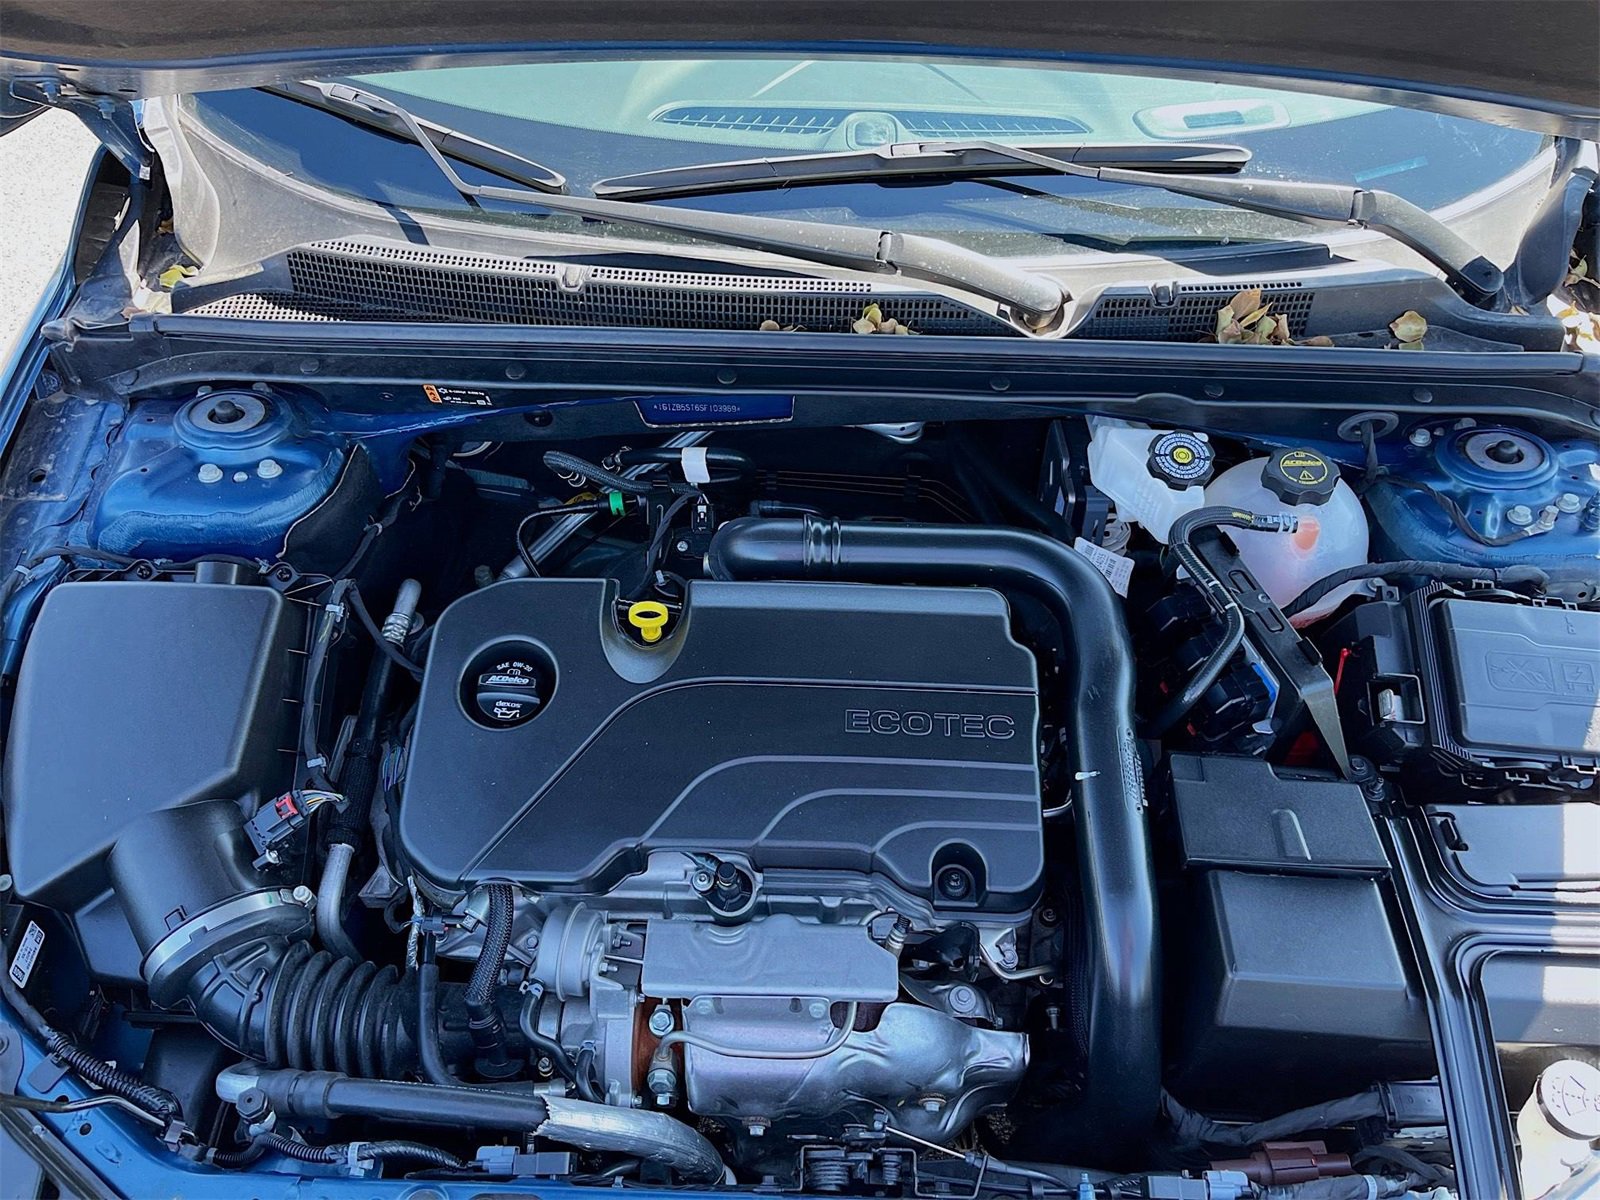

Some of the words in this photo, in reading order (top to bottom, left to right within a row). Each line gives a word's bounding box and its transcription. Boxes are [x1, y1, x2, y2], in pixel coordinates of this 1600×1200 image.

[496, 662, 510, 670] SAE
[486, 675, 529, 684] ACDelco
[495, 700, 522, 708] dexos
[845, 709, 1015, 740] ECOTEC
